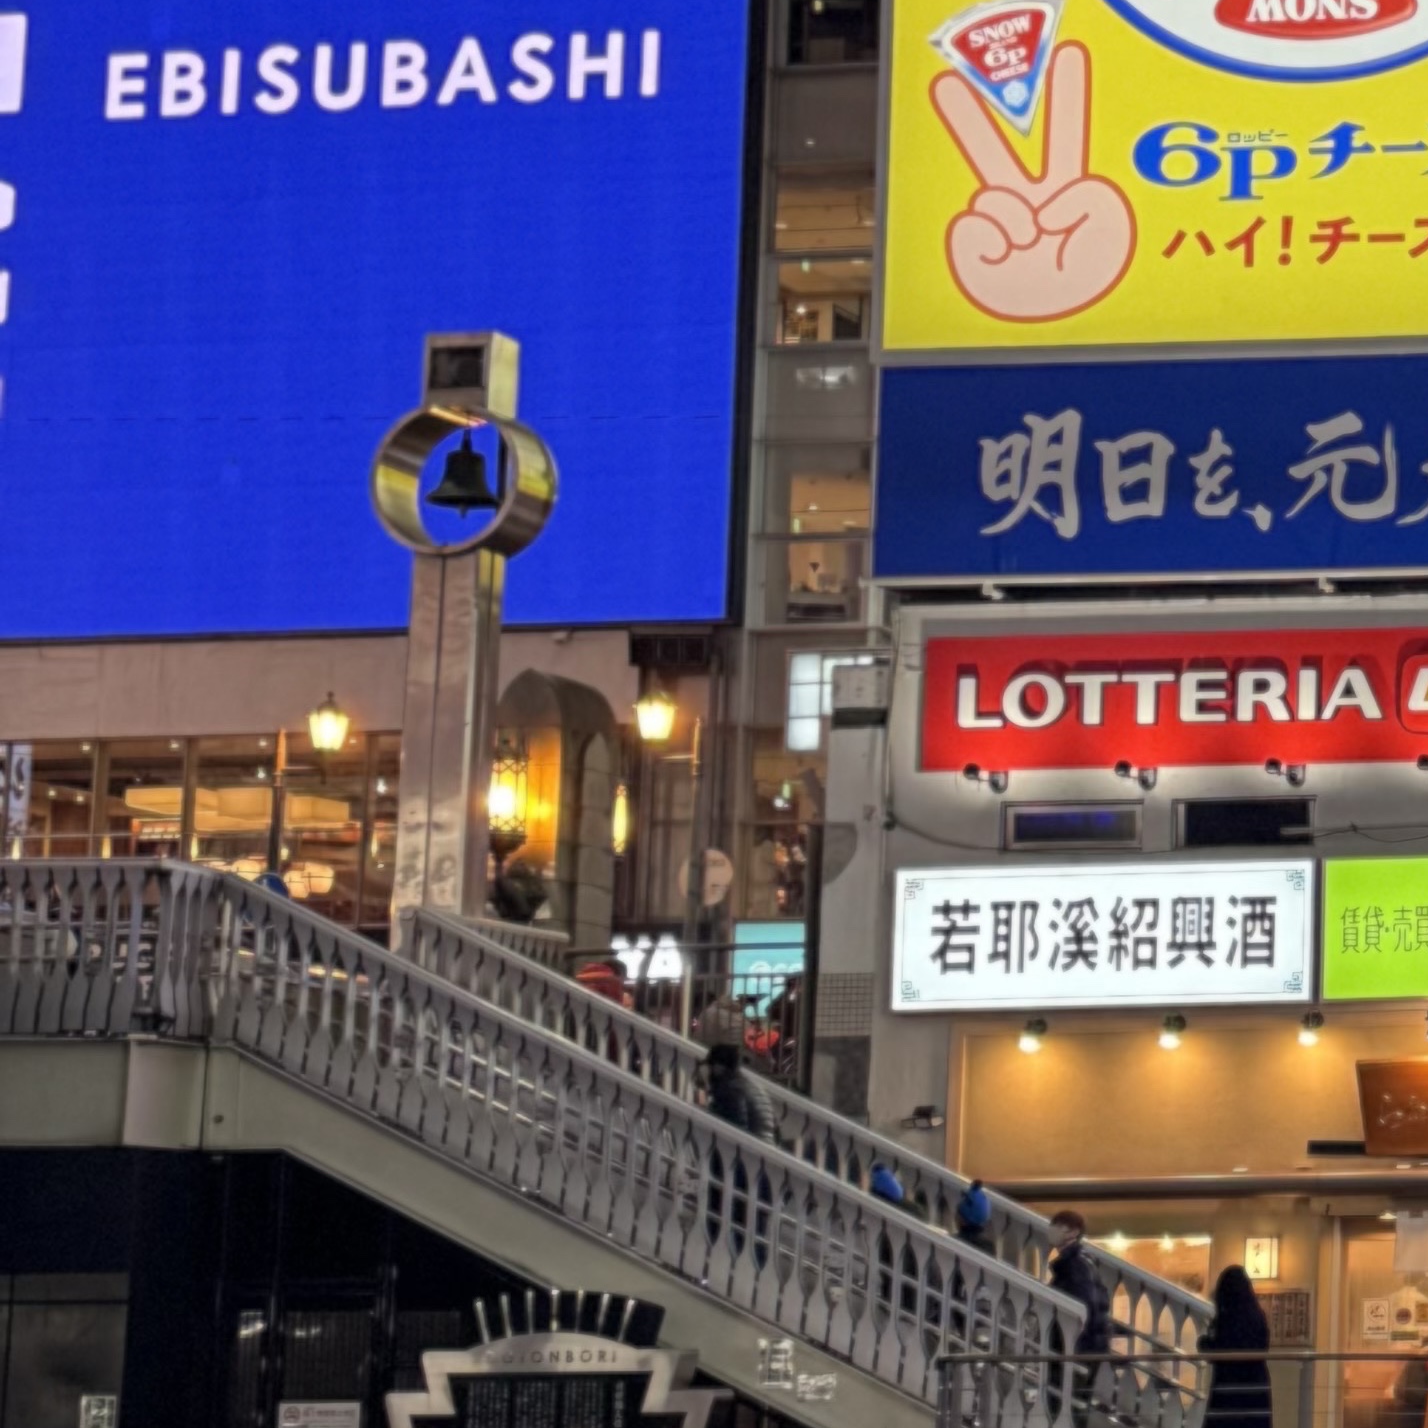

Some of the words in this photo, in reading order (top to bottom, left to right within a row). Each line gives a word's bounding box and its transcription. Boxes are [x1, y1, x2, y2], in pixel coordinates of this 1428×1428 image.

[968, 14, 1031, 49] SNOW
[104, 29, 662, 119] EBISUBASHI
[1227, 129, 1289, 143] ロッピー
[957, 665, 1384, 730] LOTTERIA
